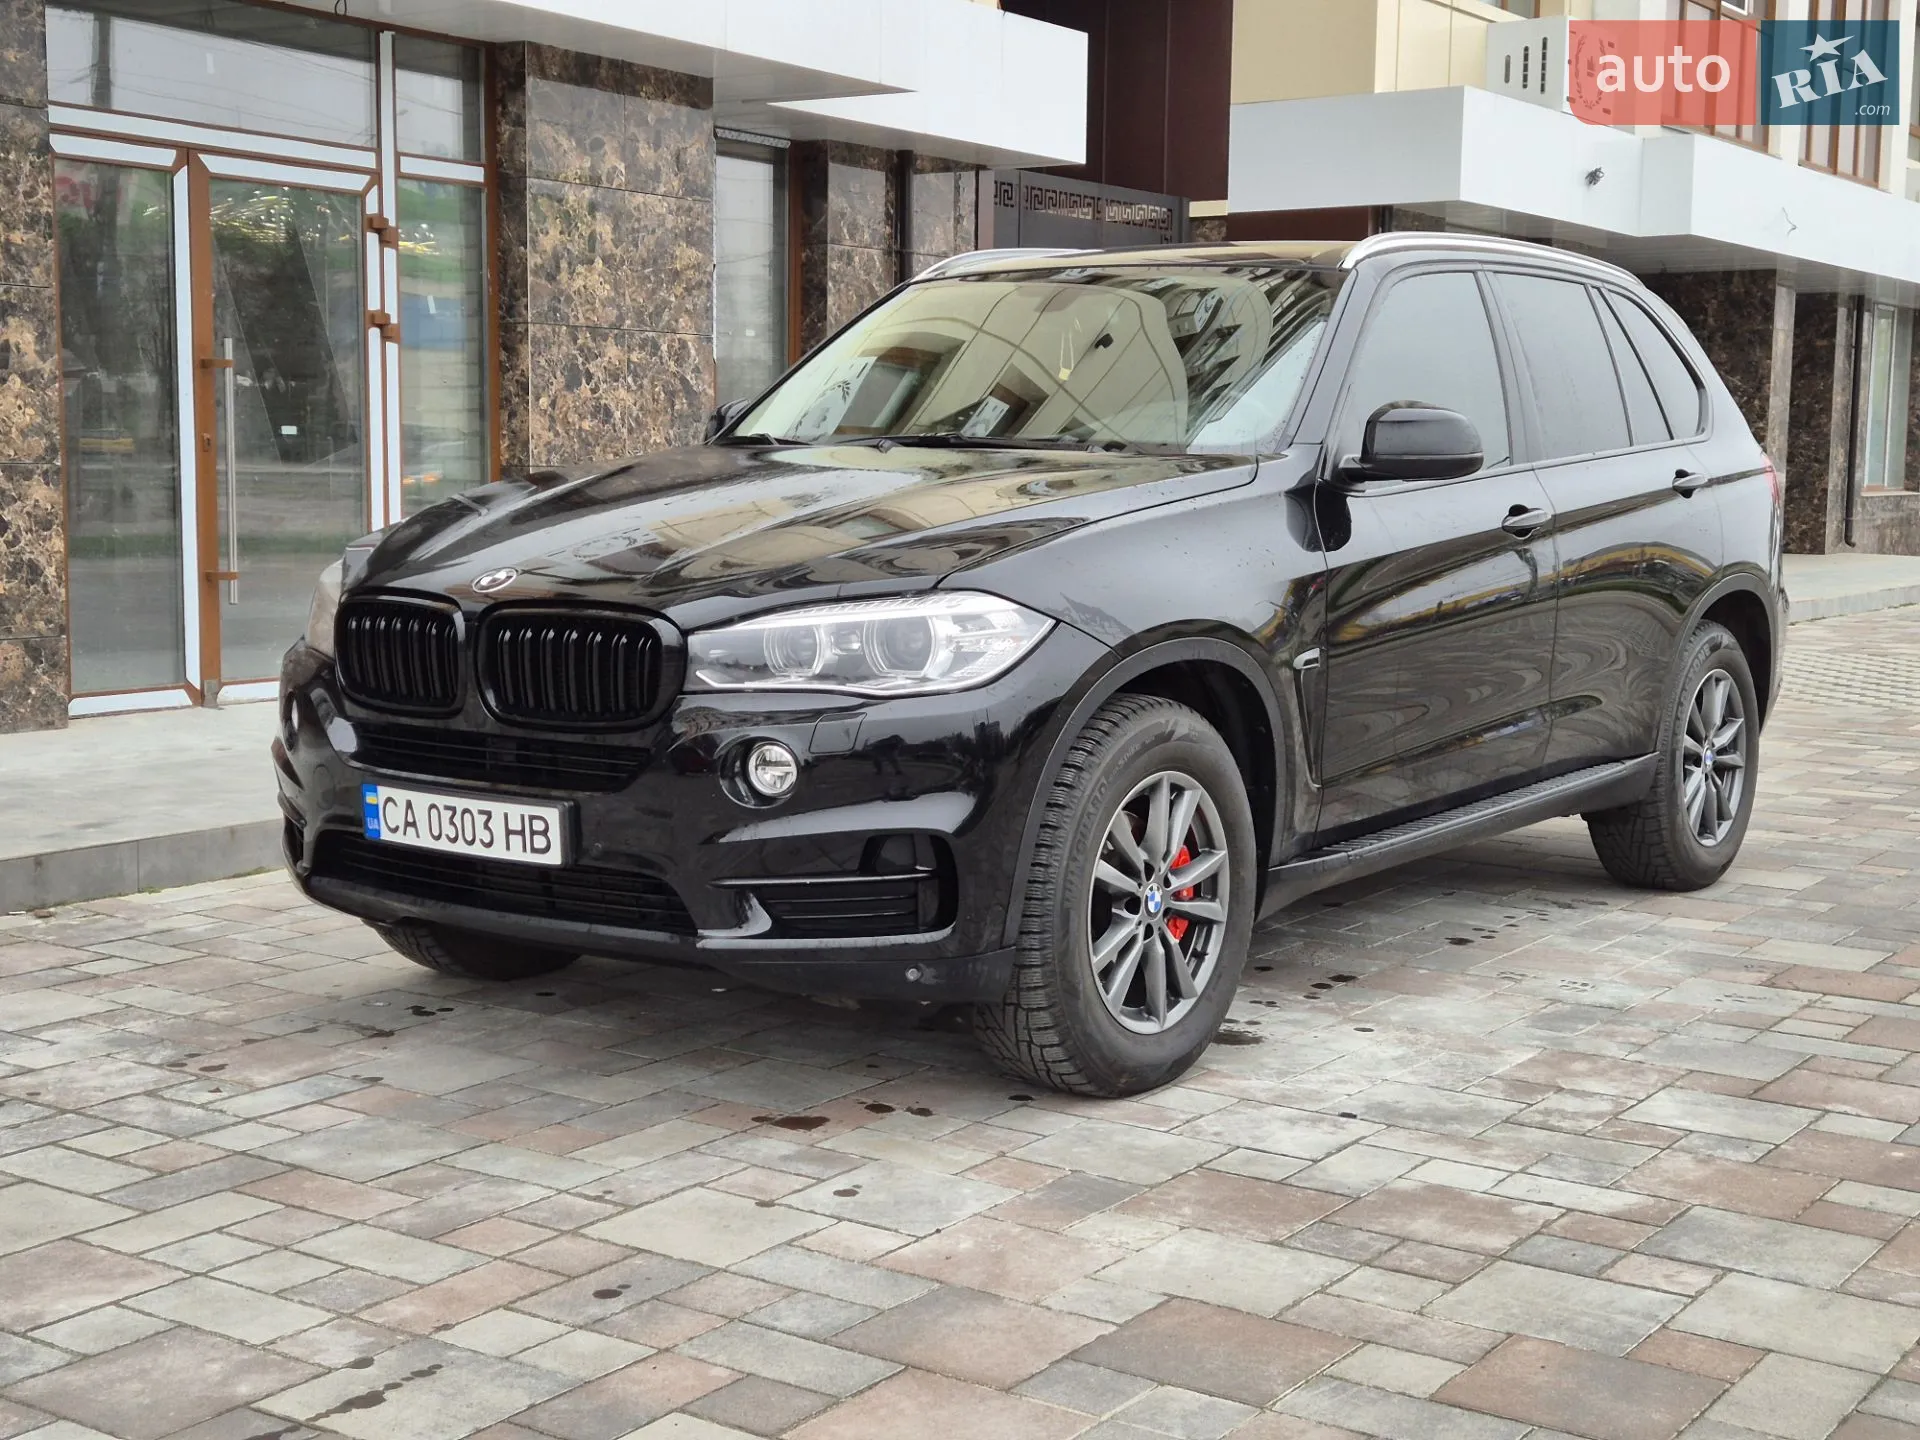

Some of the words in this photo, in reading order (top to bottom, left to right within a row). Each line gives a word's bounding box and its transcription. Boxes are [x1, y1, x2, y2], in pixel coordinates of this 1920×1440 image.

[367, 817, 380, 830] UA
[382, 796, 421, 839] CA
[427, 803, 495, 849] 0303
[503, 811, 552, 855] HB
